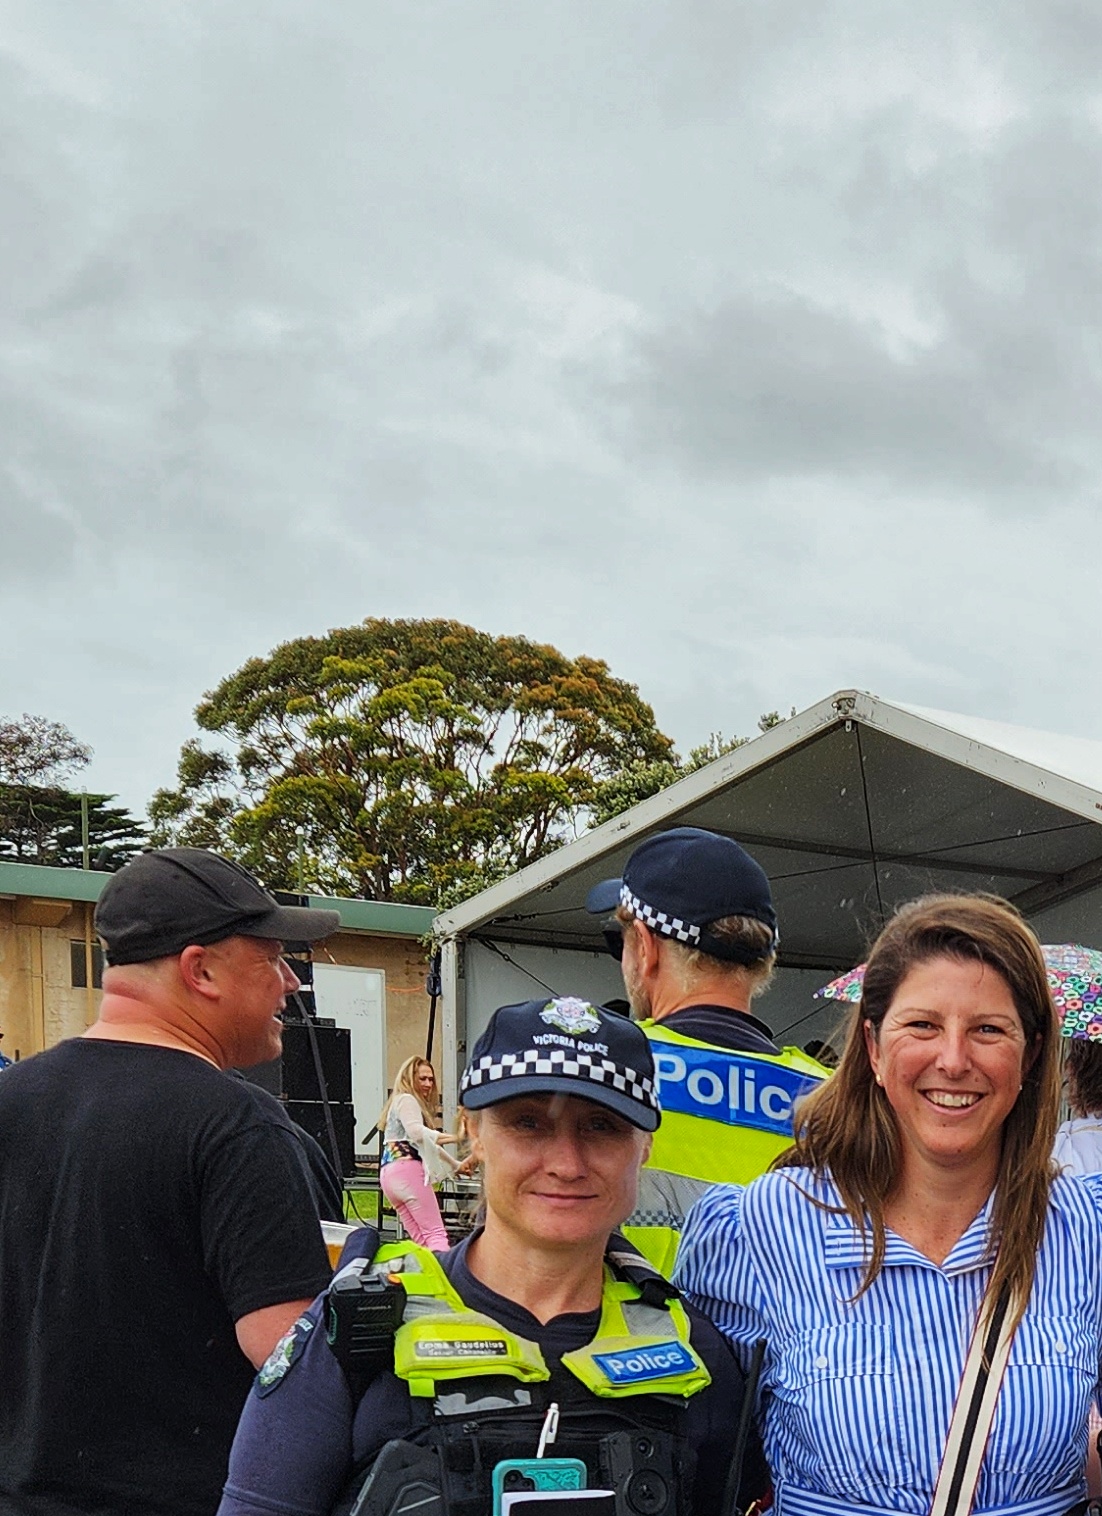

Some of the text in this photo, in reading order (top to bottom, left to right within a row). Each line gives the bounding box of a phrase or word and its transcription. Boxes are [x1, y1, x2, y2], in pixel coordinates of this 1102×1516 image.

[532, 1033, 609, 1056] VICTORIA POLICE
[652, 1053, 793, 1121] Polic
[606, 1351, 684, 1375] Police
